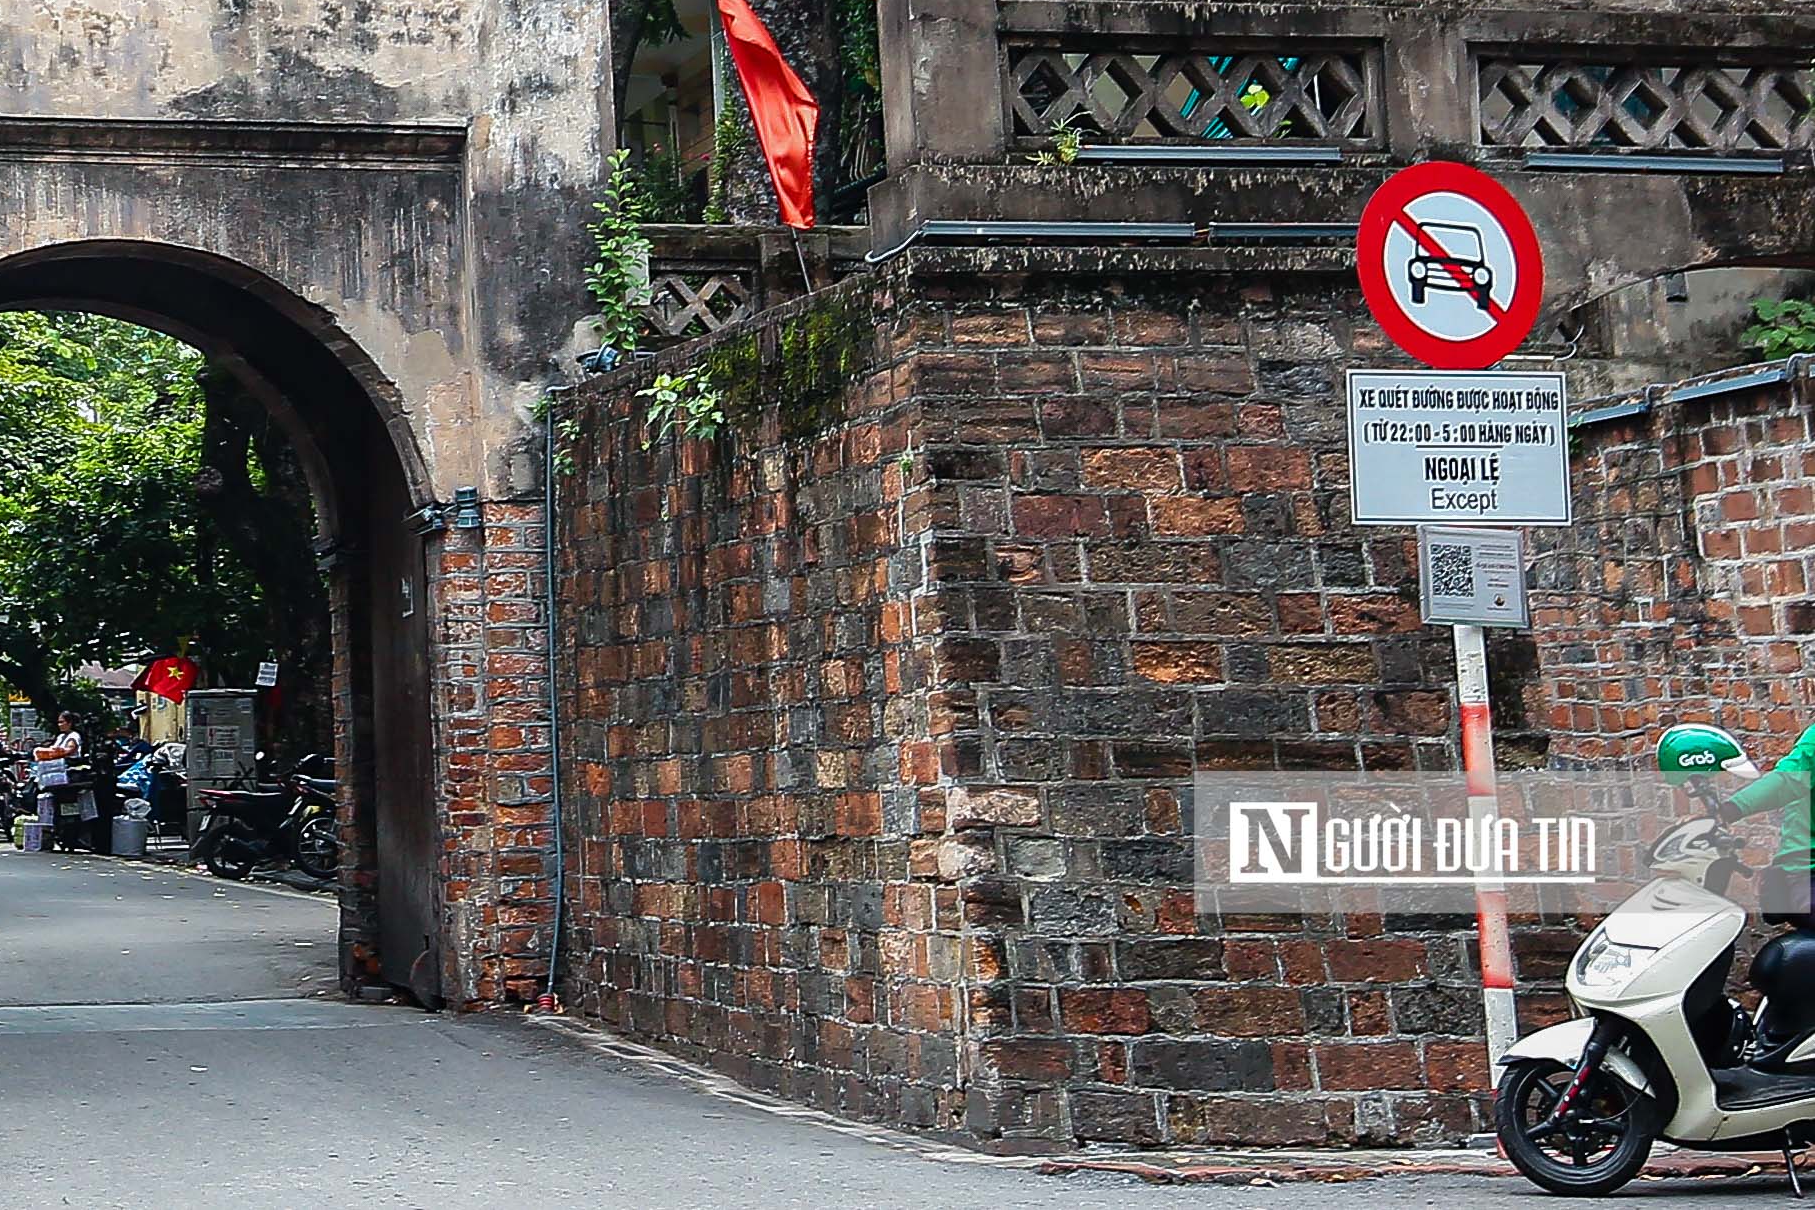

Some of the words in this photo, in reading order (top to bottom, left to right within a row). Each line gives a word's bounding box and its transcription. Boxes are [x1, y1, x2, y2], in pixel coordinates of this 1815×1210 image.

[1358, 388, 1376, 409] XE
[1378, 384, 1410, 409] QUÉT
[1412, 385, 1454, 410] ĐƯỜNG
[1456, 388, 1490, 414] ĐƯỢC
[1492, 390, 1524, 414] HOẠT
[1525, 386, 1559, 415] ĐỘNG
[1390, 422, 1432, 443] 22:00
[1478, 418, 1512, 444] HÀNG
[1424, 457, 1477, 486] NGOẠI
[1480, 452, 1501, 486] LỆ
[1431, 488, 1498, 515] Except
[1678, 750, 1716, 767] Grab
